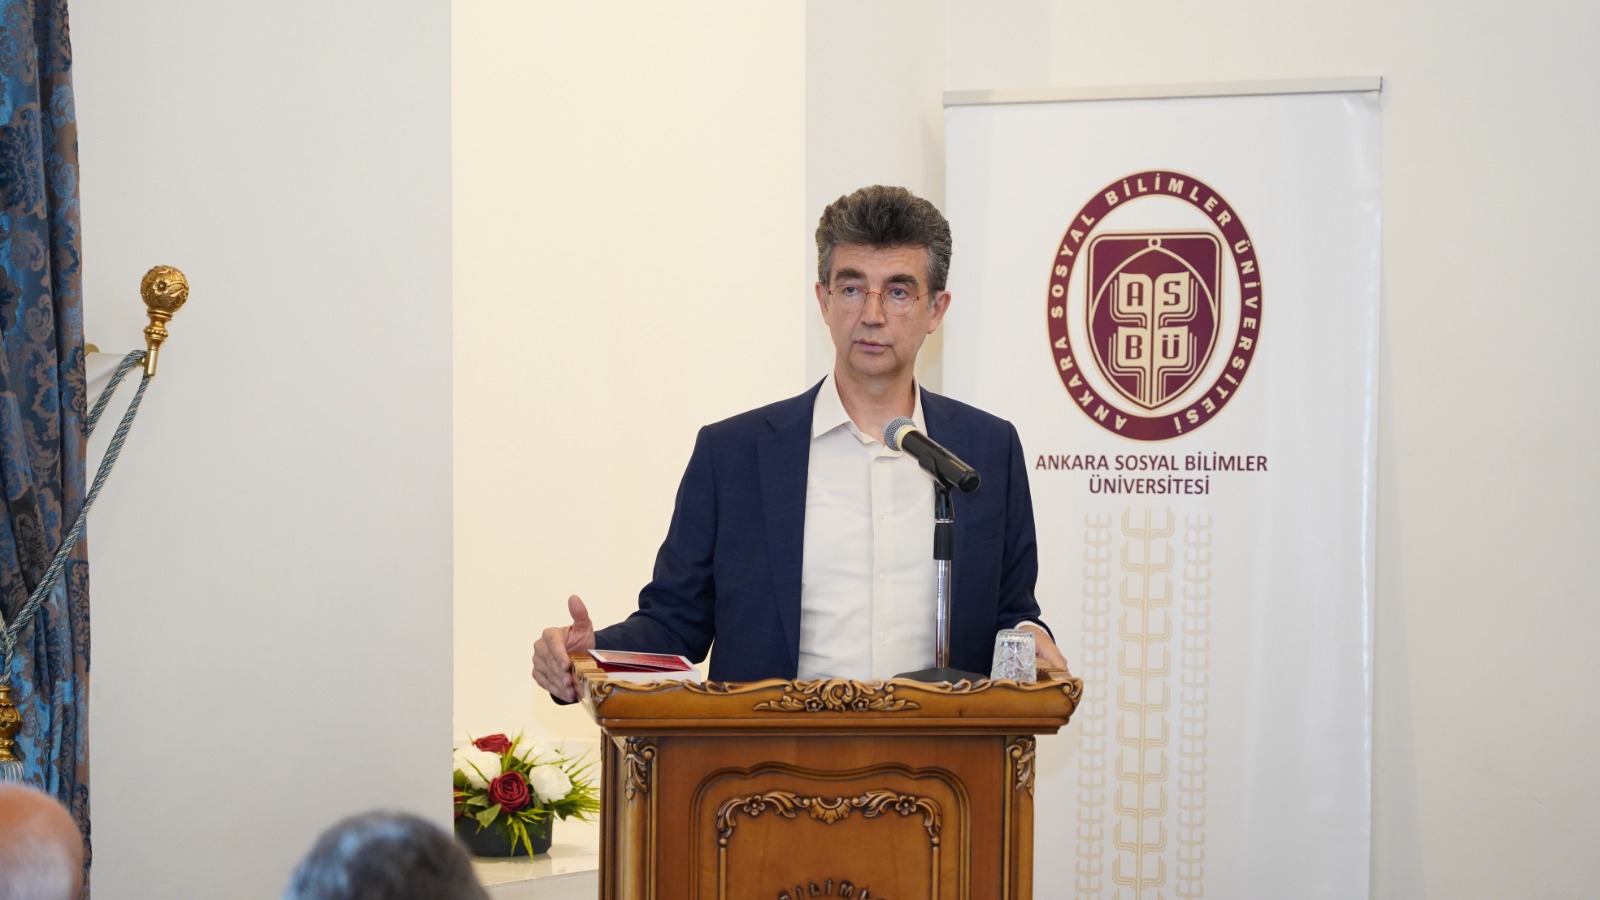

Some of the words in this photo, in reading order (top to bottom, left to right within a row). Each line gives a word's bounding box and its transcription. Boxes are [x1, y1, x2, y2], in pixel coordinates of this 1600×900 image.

[1104, 172, 1232, 228] BİLİMLER
[1050, 213, 1096, 319] SOSYAL
[1173, 238, 1261, 434] ÜNİVERSİTESİ
[1054, 335, 1128, 430] ANKARA
[1035, 454, 1110, 471] ANKARA
[1114, 454, 1180, 471] SOSYAL
[1184, 451, 1269, 472] BİLİMLER
[1088, 474, 1211, 495] ÜNİVERSİTESİ
